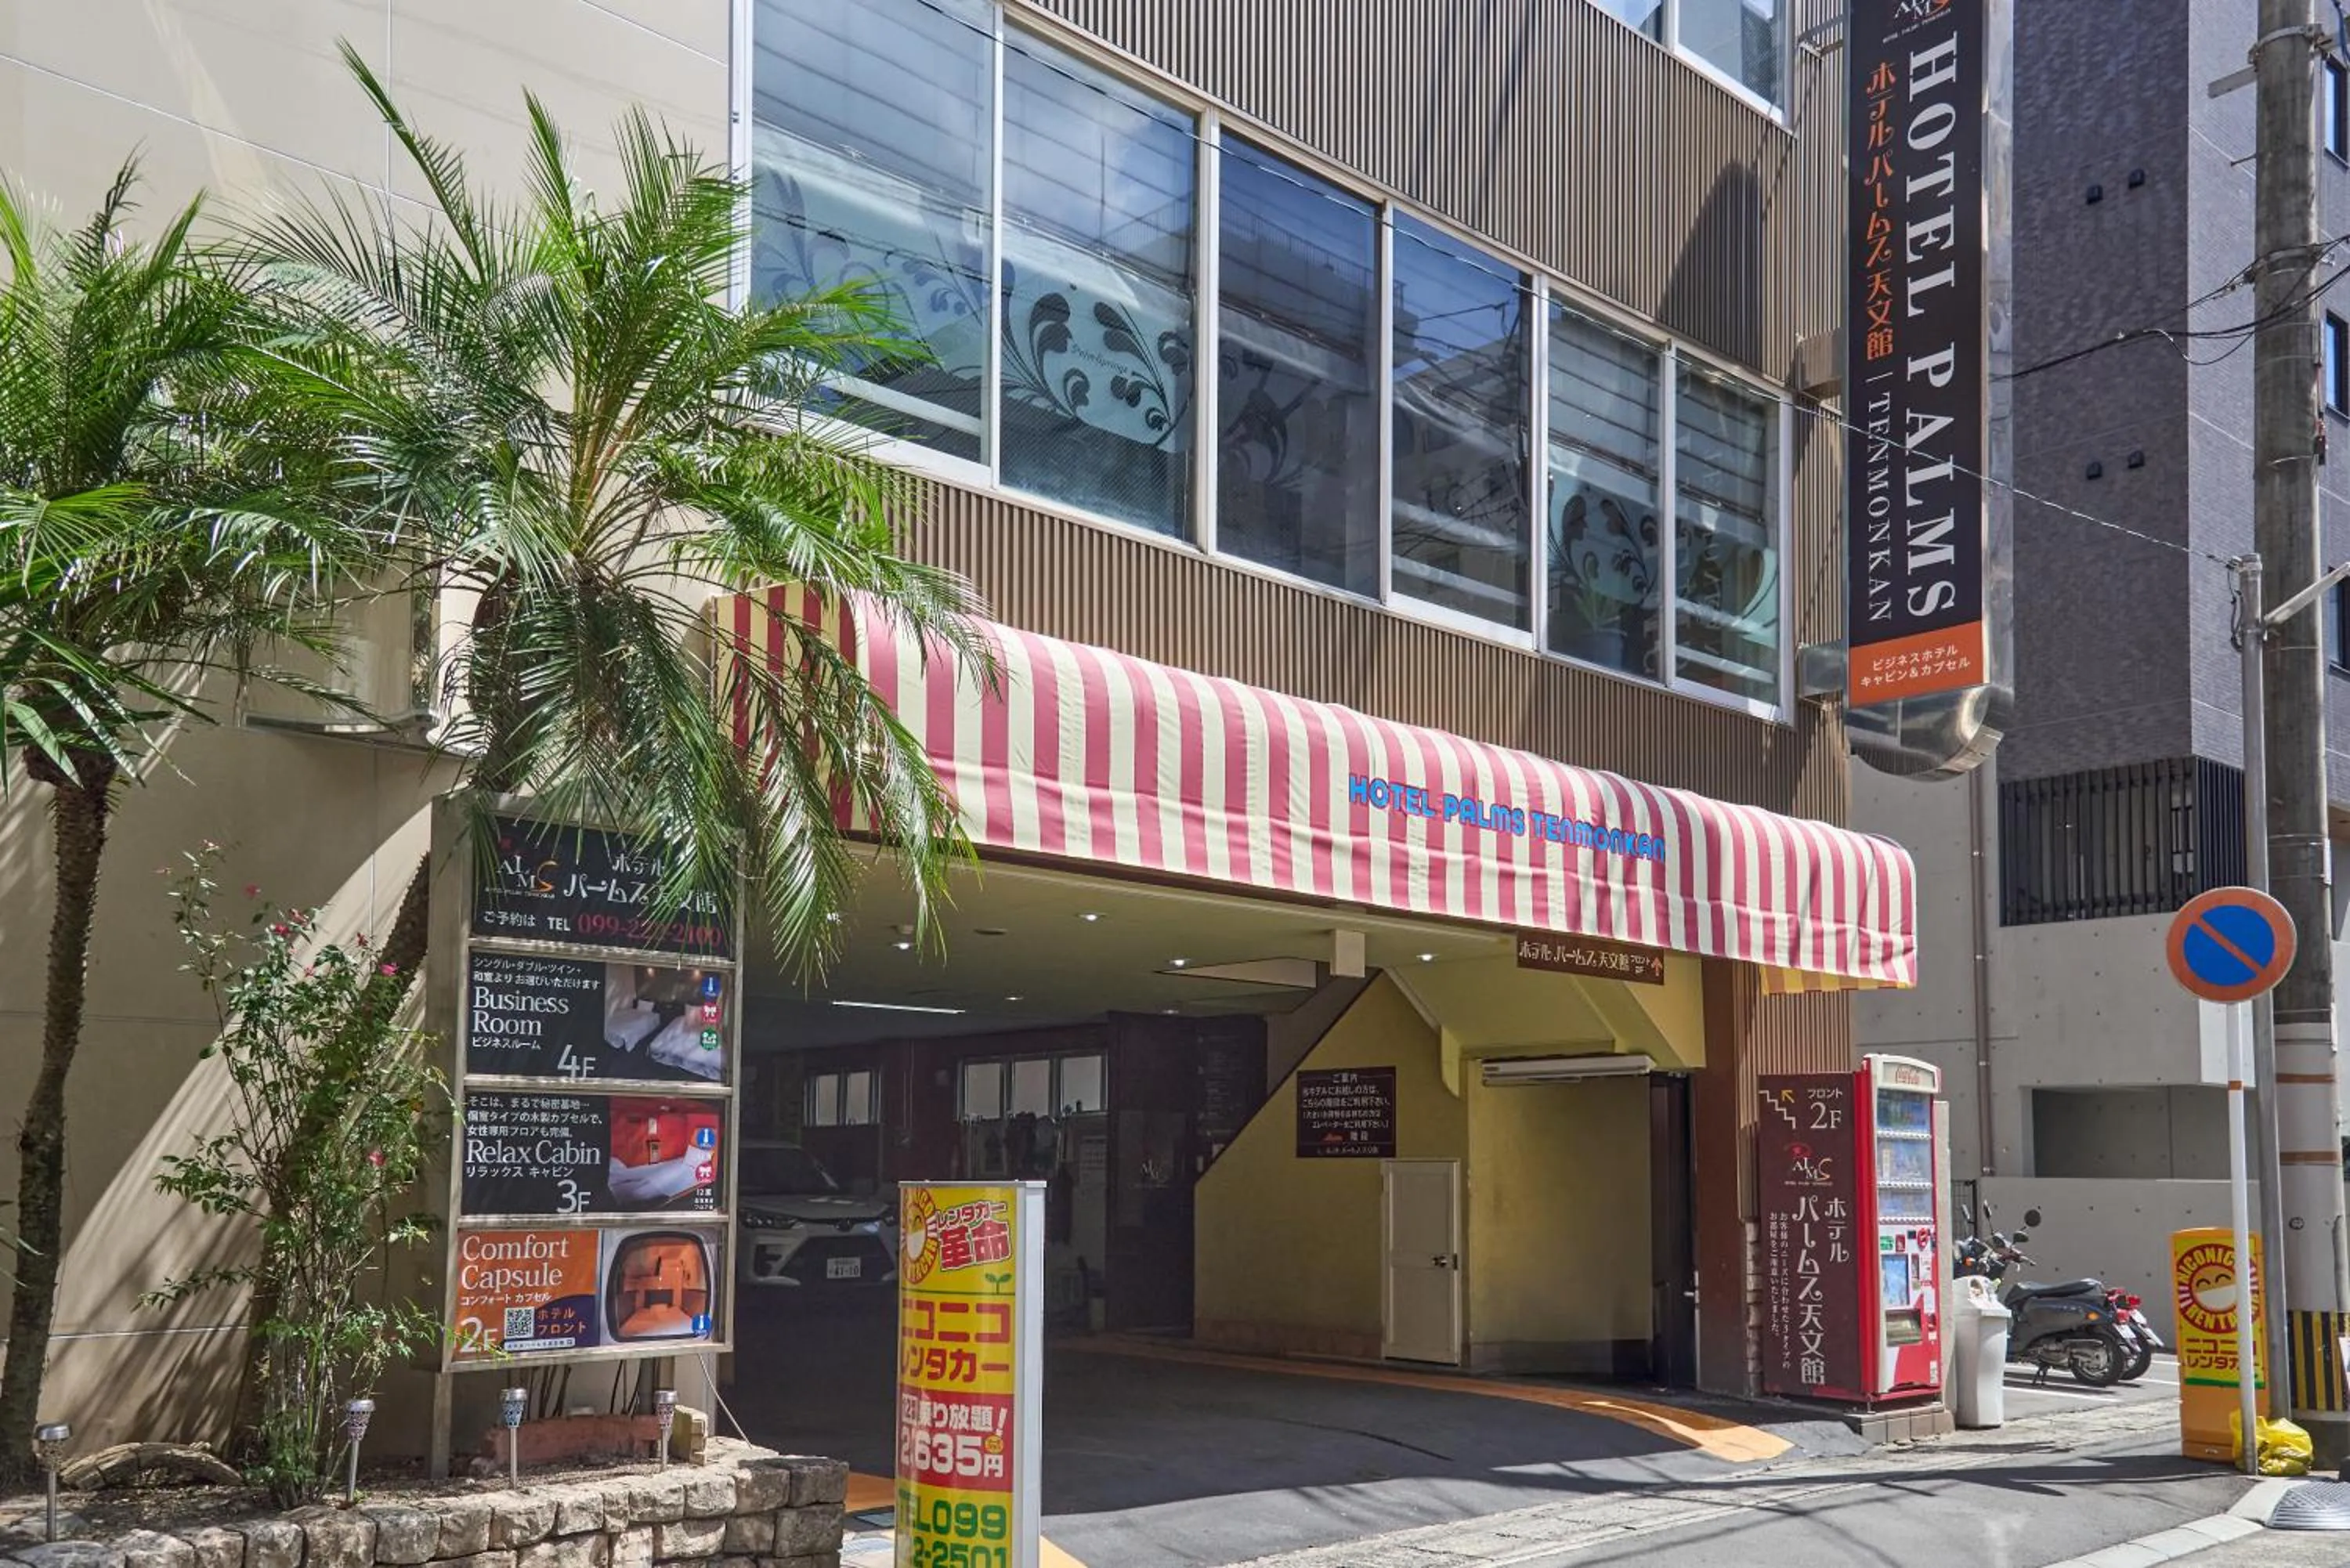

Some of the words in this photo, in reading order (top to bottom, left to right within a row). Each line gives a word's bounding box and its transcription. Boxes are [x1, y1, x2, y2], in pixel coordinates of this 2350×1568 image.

[1907, 31, 1958, 317] HOTEL
[1906, 342, 1955, 617] PALMS
[1867, 392, 1892, 623] TENMONKAN
[1872, 645, 1958, 671] ビジネスホテル
[1349, 774, 1437, 817] HOTEL
[1443, 793, 1526, 836] PALMS
[1531, 811, 1665, 862] TENMONKAN
[612, 853, 666, 876] ホテル
[483, 910, 536, 927] ご予約は
[548, 916, 570, 931] TEL
[472, 986, 570, 1014] Business
[472, 1010, 542, 1035] Room
[472, 1036, 541, 1050] ビジネスルーム
[557, 1043, 596, 1078] 4F
[1807, 1088, 1843, 1098] フロント
[1810, 1102, 1842, 1129] 2F
[465, 1139, 530, 1164] Relax
[535, 1140, 601, 1165] Cabin
[466, 1165, 524, 1178] リラックス
[530, 1165, 574, 1177] キャビン
[557, 1179, 591, 1213] 3F
[936, 1201, 1007, 1228] レンタカー
[1824, 1197, 1849, 1263] ホテル
[462, 1234, 569, 1262] Comfort
[940, 1221, 1011, 1270] 革命
[461, 1263, 564, 1293] Capsule
[1791, 1195, 1825, 1386] パームス天文館
[460, 1295, 512, 1306] コンフォート
[537, 1307, 576, 1321] ホテル
[458, 1317, 498, 1353] 2F
[537, 1321, 587, 1335] フロント
